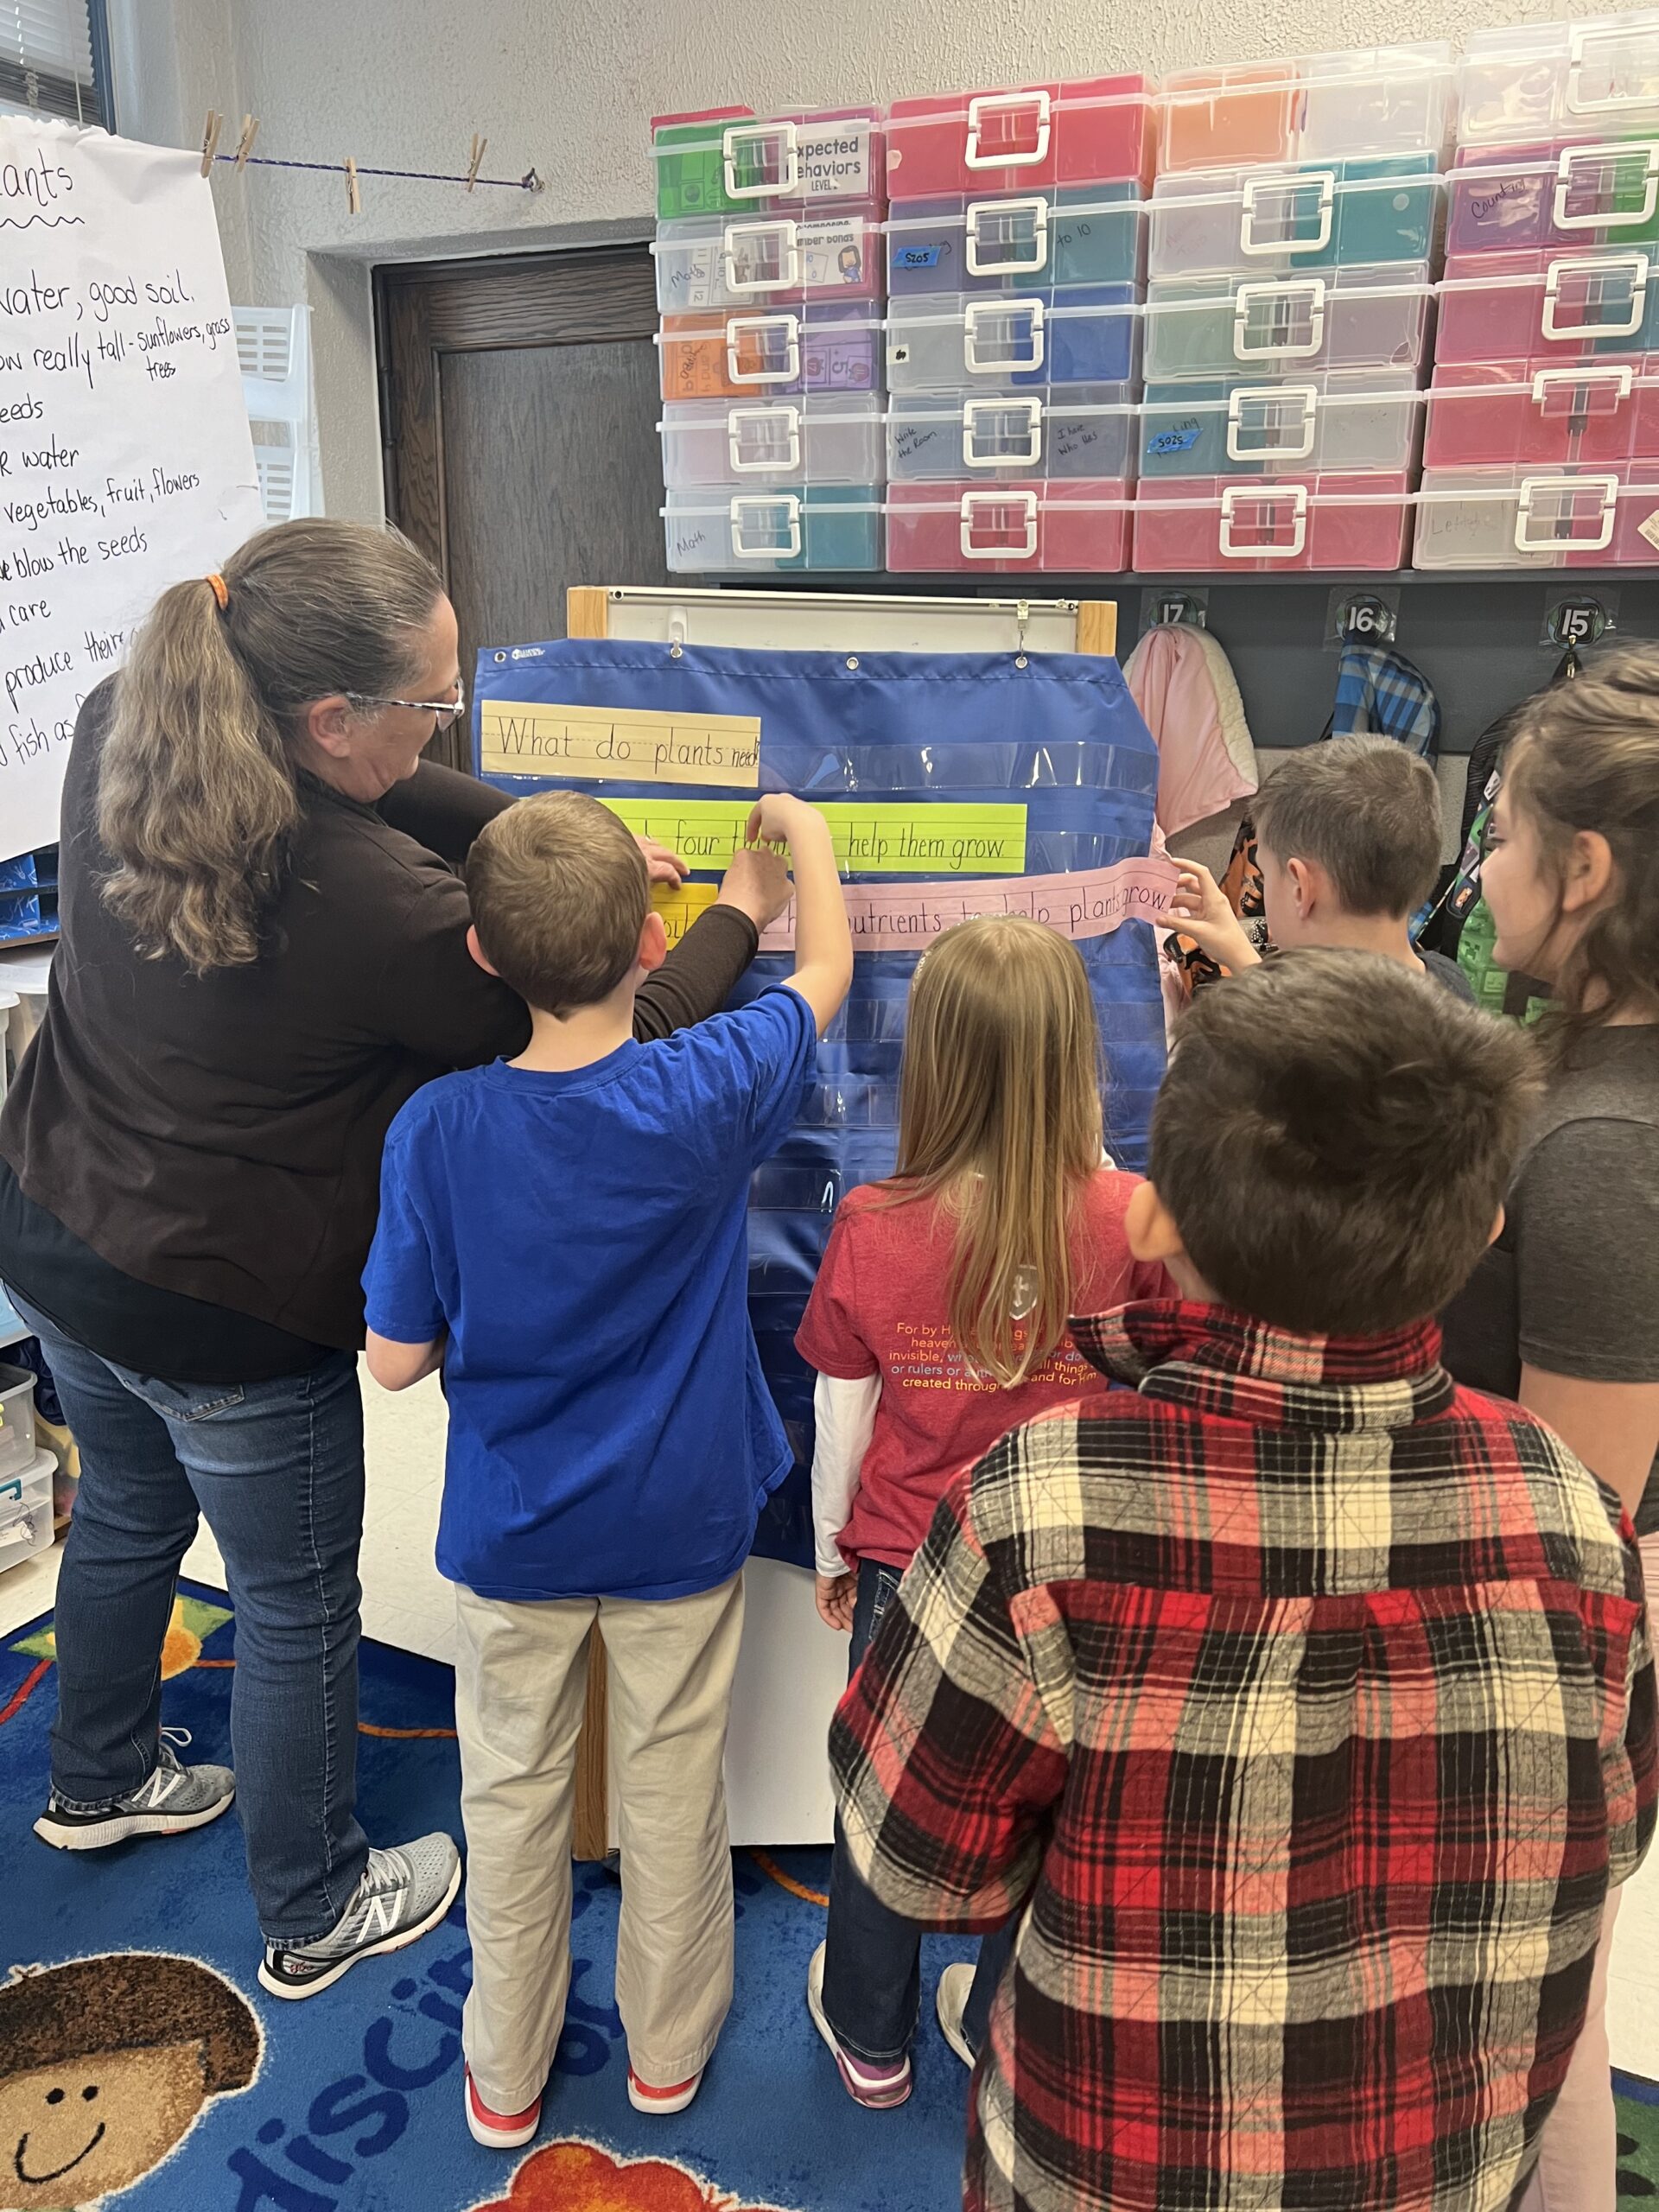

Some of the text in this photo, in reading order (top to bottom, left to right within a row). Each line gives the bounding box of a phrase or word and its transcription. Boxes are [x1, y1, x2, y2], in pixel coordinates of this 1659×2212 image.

[796, 136, 859, 162] xpected
[0, 147, 73, 207] ants
[785, 160, 861, 183] ehaviors
[89, 276, 137, 322] good
[146, 269, 194, 304] soil.
[33, 332, 93, 389] really
[206, 318, 231, 351] grass
[22, 434, 79, 470] water
[154, 467, 200, 498] flowers
[13, 547, 54, 578] blow
[57, 536, 90, 565] the
[98, 525, 148, 561] seeds
[677, 530, 706, 556] Math
[9, 600, 52, 626] care
[1163, 603, 1184, 624] 17
[1348, 607, 1374, 632] 16
[1560, 607, 1592, 637] 15
[5, 652, 74, 714] produce
[8, 717, 50, 766] fish
[498, 715, 573, 758] What
[595, 723, 631, 760] do
[654, 727, 724, 775] plants
[676, 818, 720, 855] four
[849, 822, 889, 863] help
[899, 828, 944, 859] them
[1070, 885, 1121, 933] plants
[897, 1322, 918, 1335] For
[921, 1324, 938, 1338] by
[889, 1350, 944, 1363] invisible,
[891, 1365, 904, 1375] or
[907, 1363, 944, 1376] rulers
[946, 1367, 961, 1376] or
[1054, 1361, 1088, 1375] things
[902, 1377, 951, 1389] created
[1030, 1372, 1055, 1382] and
[1058, 1374, 1077, 1386] for
